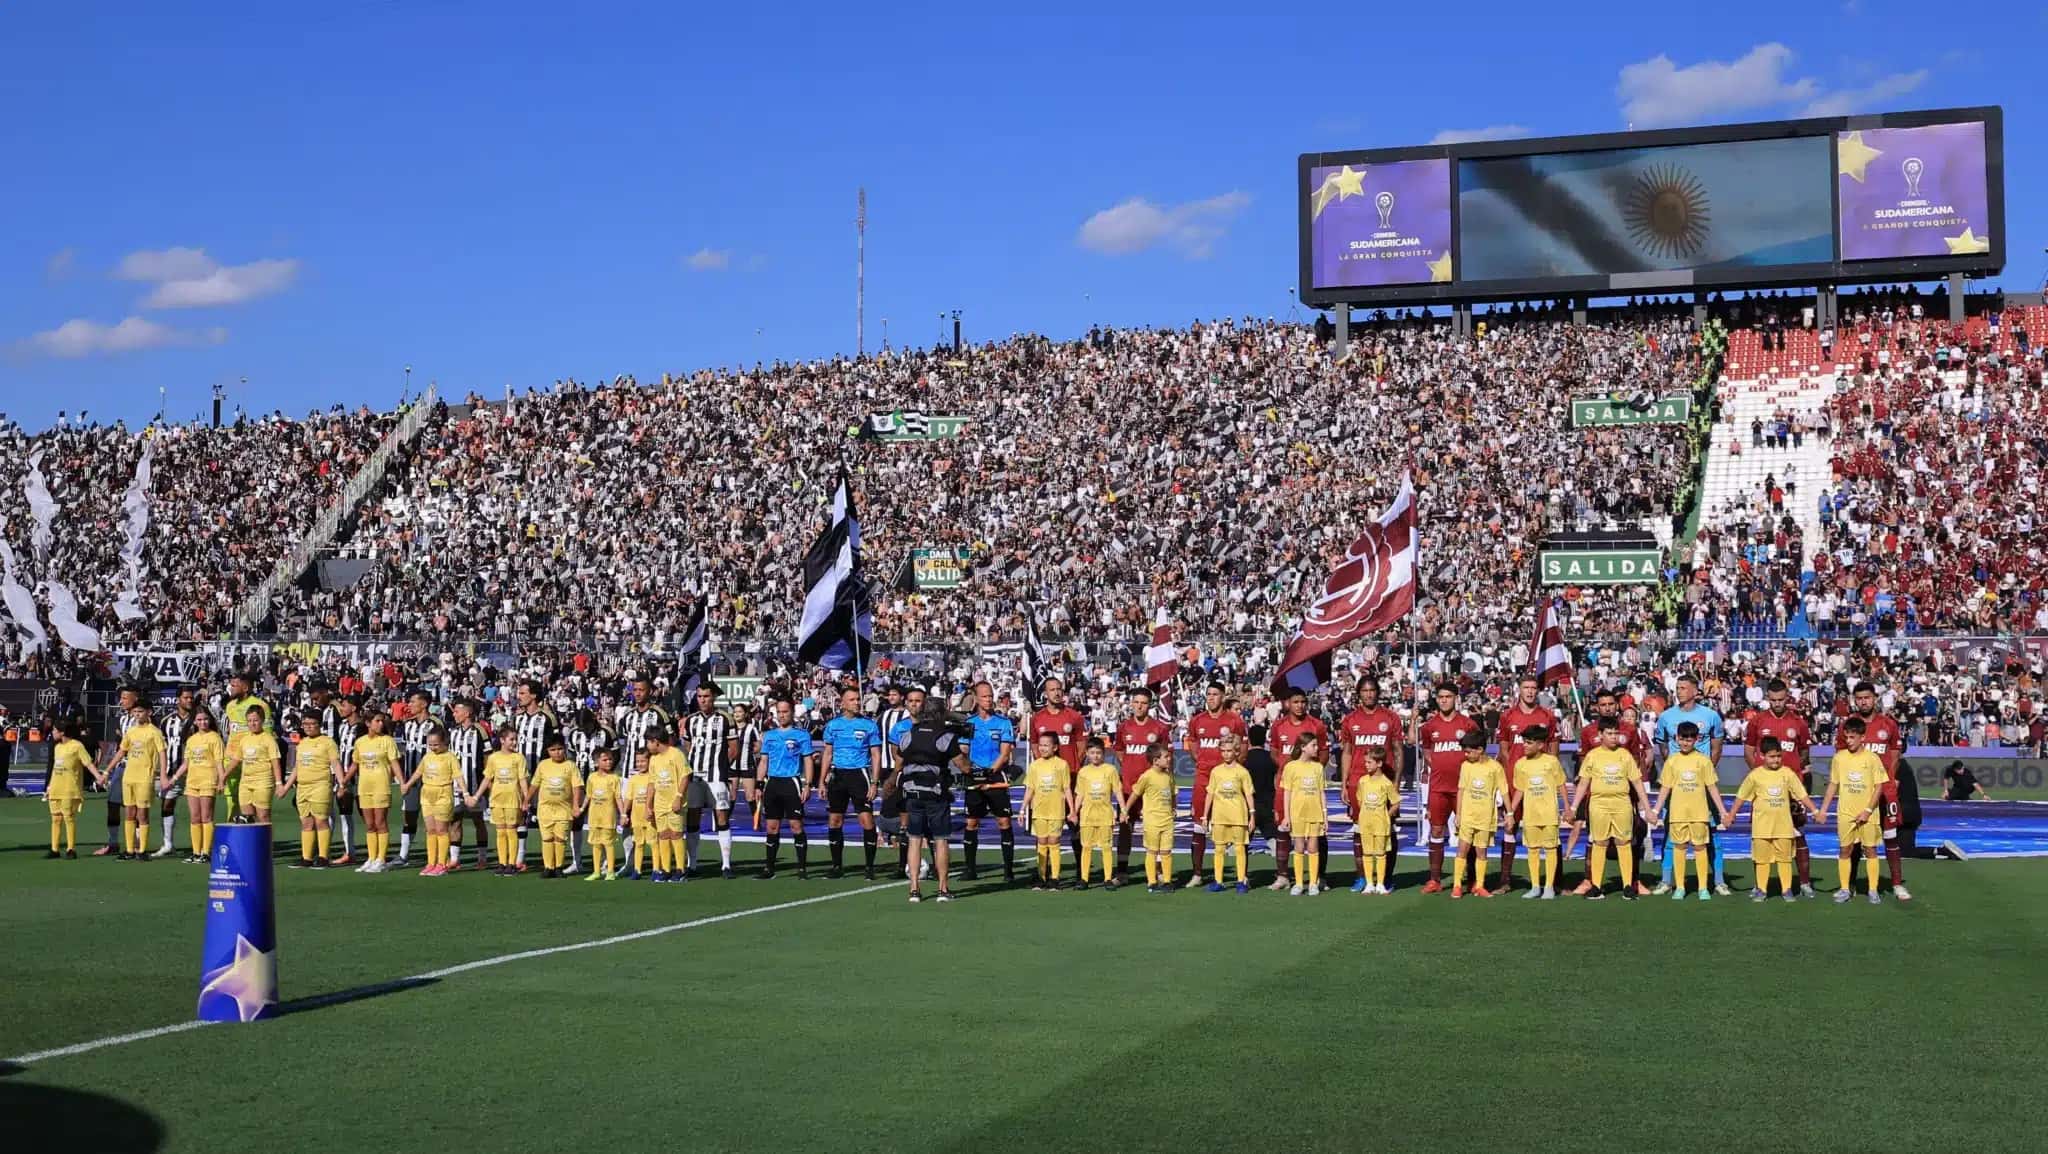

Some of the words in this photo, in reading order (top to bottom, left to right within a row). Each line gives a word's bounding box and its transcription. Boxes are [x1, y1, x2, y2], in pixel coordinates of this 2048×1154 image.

[1874, 206, 1954, 218] SUDAMERICANA
[1872, 222, 1909, 230] GRANDE
[1912, 218, 1968, 227] CONQUISTA
[1350, 238, 1420, 249] SUDAMERICANA
[1381, 249, 1433, 259] CONQUISTA
[1549, 560, 1656, 575] SALIDA
[918, 569, 960, 581] SALID
[1200, 738, 1220, 748] MAP
[1355, 735, 1387, 745] MAPEI
[1126, 744, 1148, 754] MAP
[1780, 740, 1795, 752] PEI
[1862, 743, 1886, 754] APEI
